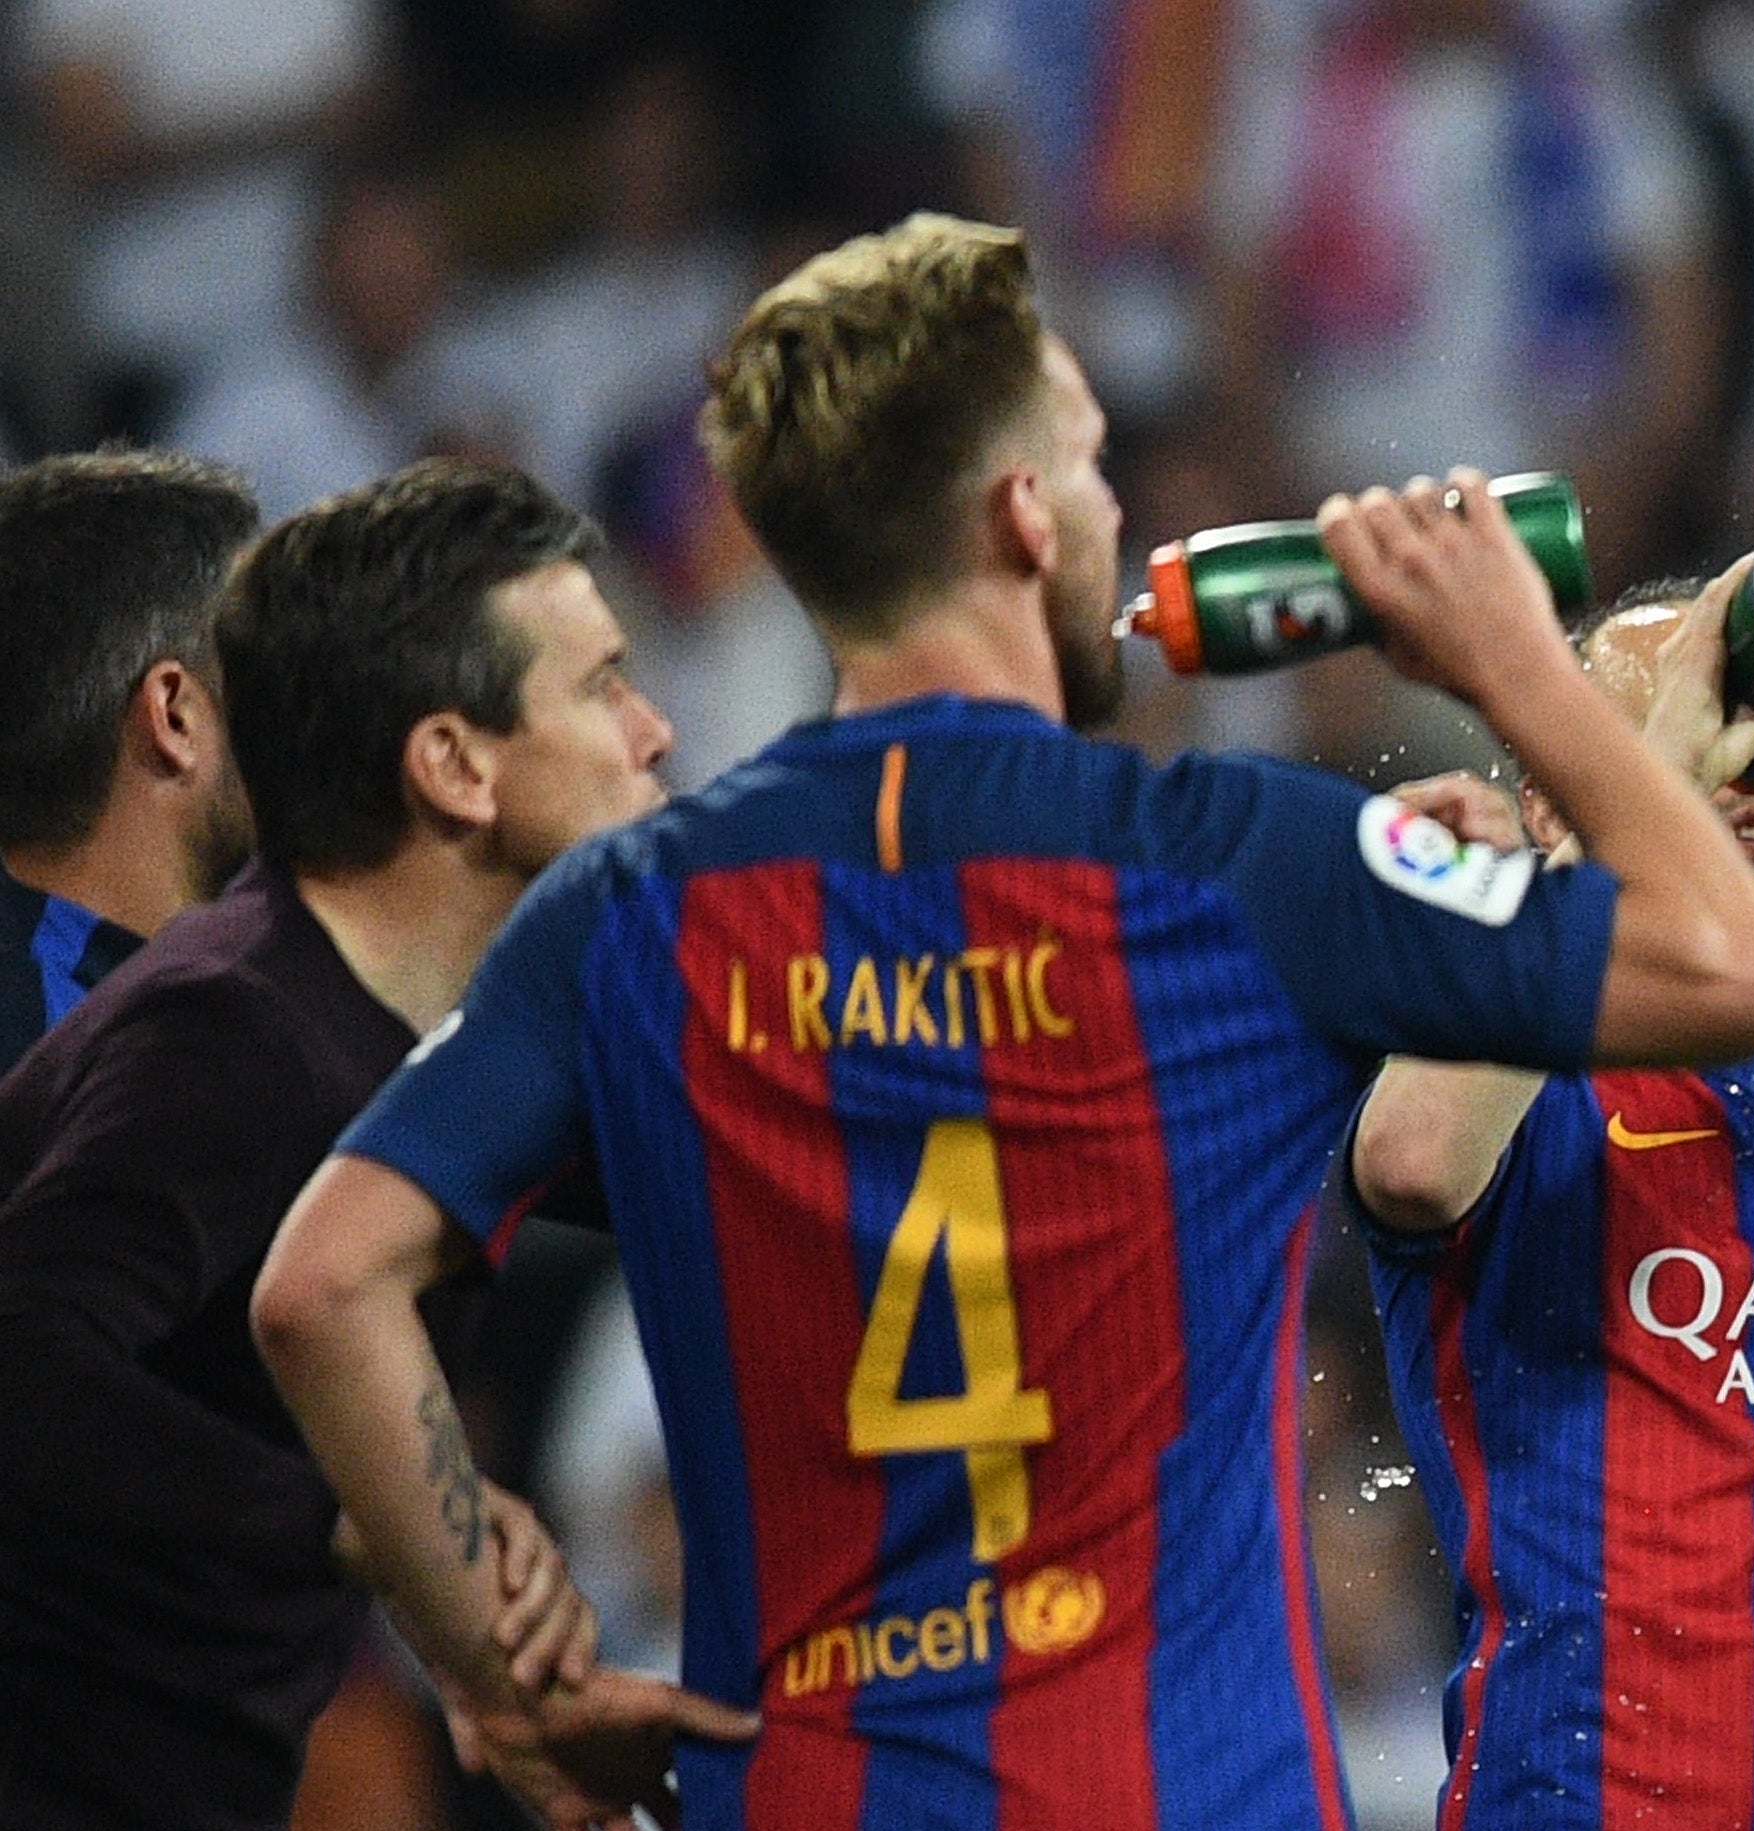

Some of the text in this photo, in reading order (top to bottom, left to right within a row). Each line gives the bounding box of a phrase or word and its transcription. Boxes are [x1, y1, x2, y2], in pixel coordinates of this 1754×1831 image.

[728, 925, 1076, 1054] I. RAKITIĆ
[848, 1120, 1053, 1563] 4
[784, 1579, 994, 1697] unicef
